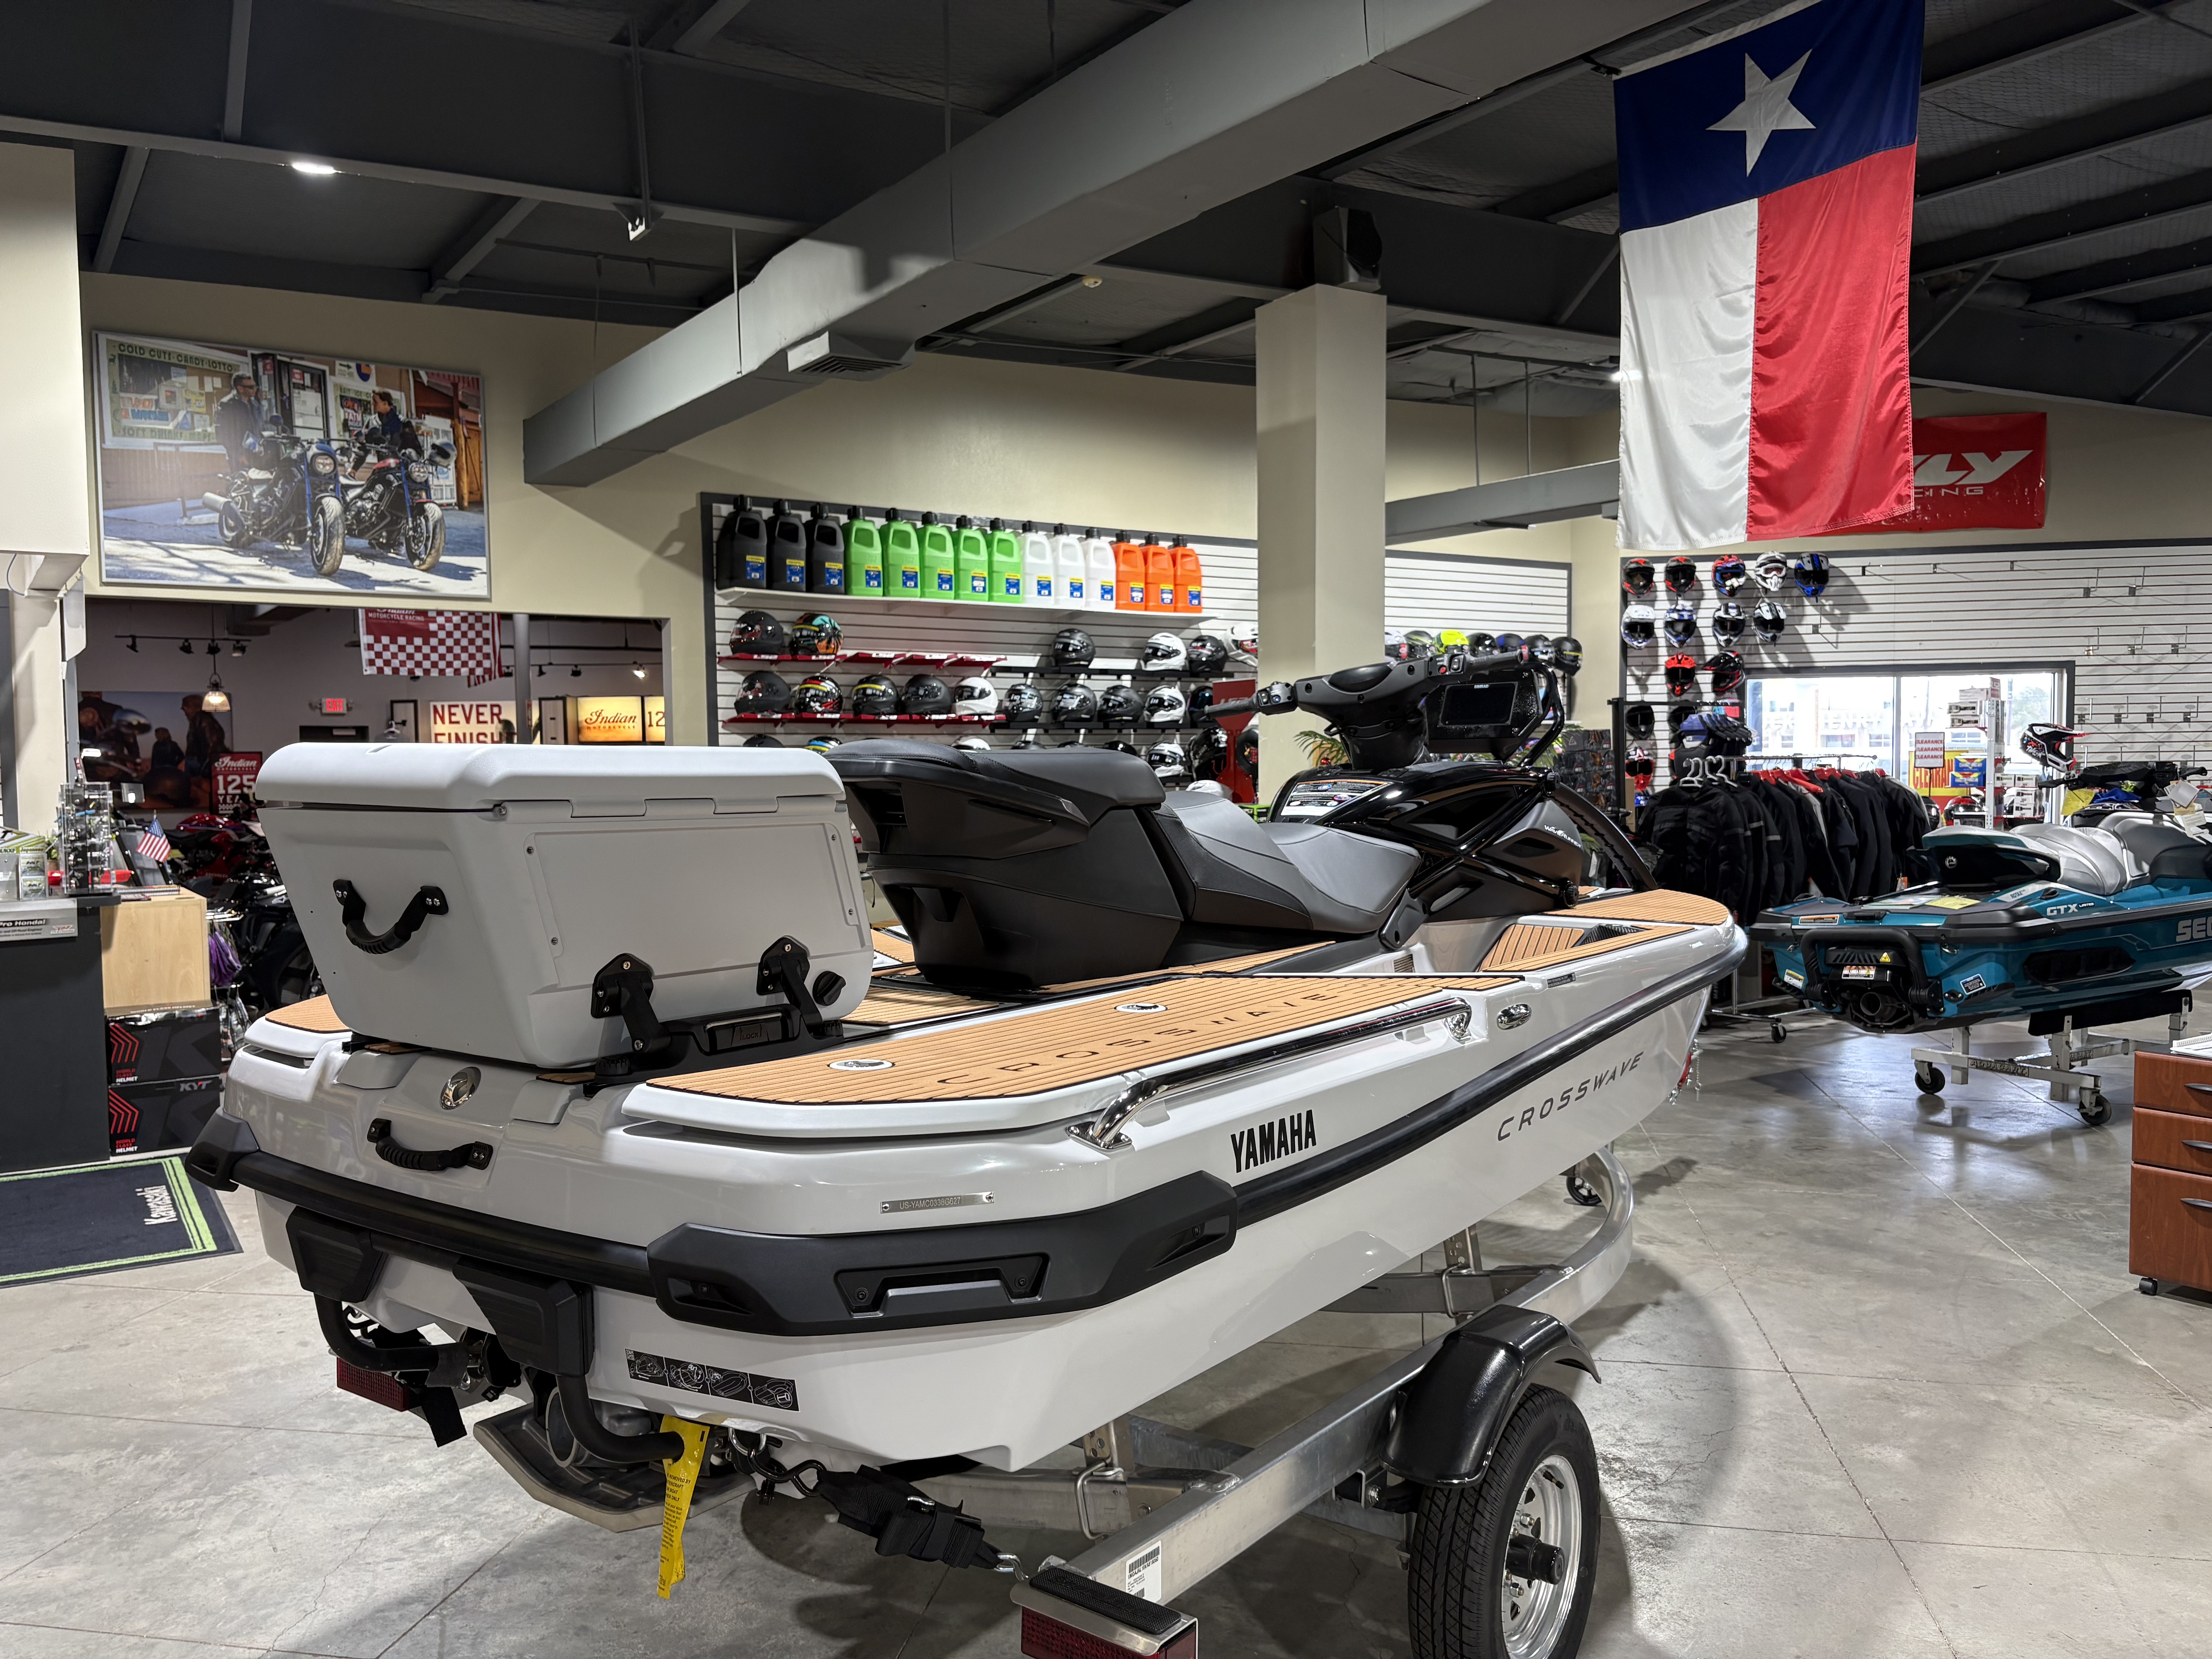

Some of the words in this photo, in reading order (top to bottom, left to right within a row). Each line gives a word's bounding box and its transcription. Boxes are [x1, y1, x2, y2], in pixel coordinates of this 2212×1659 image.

[118, 343, 145, 356] COLD
[149, 349, 171, 361] CUTS
[177, 354, 204, 367] CANDY
[208, 360, 233, 372] LOTTO
[1914, 450, 2033, 487] LY
[369, 612, 404, 620] MOTORCYCLE
[326, 699, 343, 712] EXIT
[433, 703, 502, 725] NEVER
[584, 709, 637, 725] Indian
[434, 732, 517, 744] FINISH
[215, 756, 257, 768] Indian
[217, 775, 256, 794] 125
[2046, 903, 2078, 916] GTX
[742, 1032, 759, 1040] LOCK
[936, 993, 1339, 1085] CROSSWAVE
[179, 1080, 212, 1092] KYT
[1497, 1051, 1644, 1142] CROSSWAVE
[1231, 1109, 1317, 1174] YAMAHA
[135, 1185, 178, 1225] Kawasaki
[900, 1197, 961, 1209] US-YAMC0338G627
[670, 1474, 685, 1483] REMOVED
